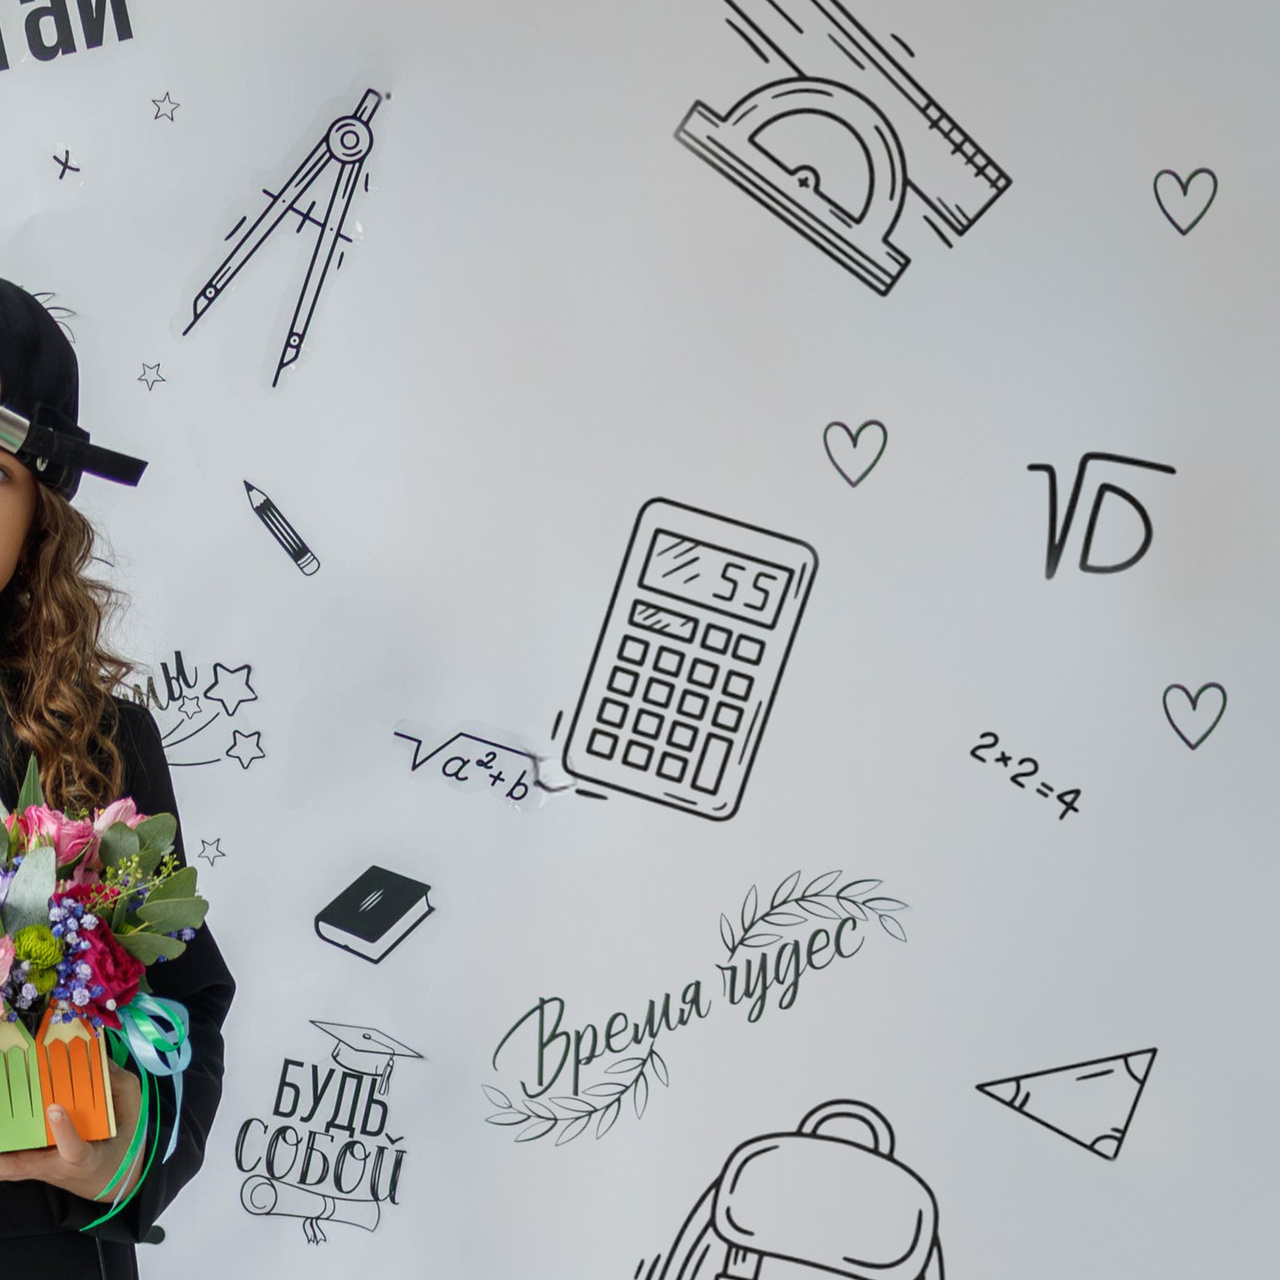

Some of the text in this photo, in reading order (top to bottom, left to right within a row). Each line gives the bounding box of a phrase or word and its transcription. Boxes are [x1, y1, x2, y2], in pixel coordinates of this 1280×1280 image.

[492, 917, 865, 1099] Время чудес
[272, 1058, 389, 1139] БУДЬ
[235, 1117, 408, 1205] СОБОЙ
